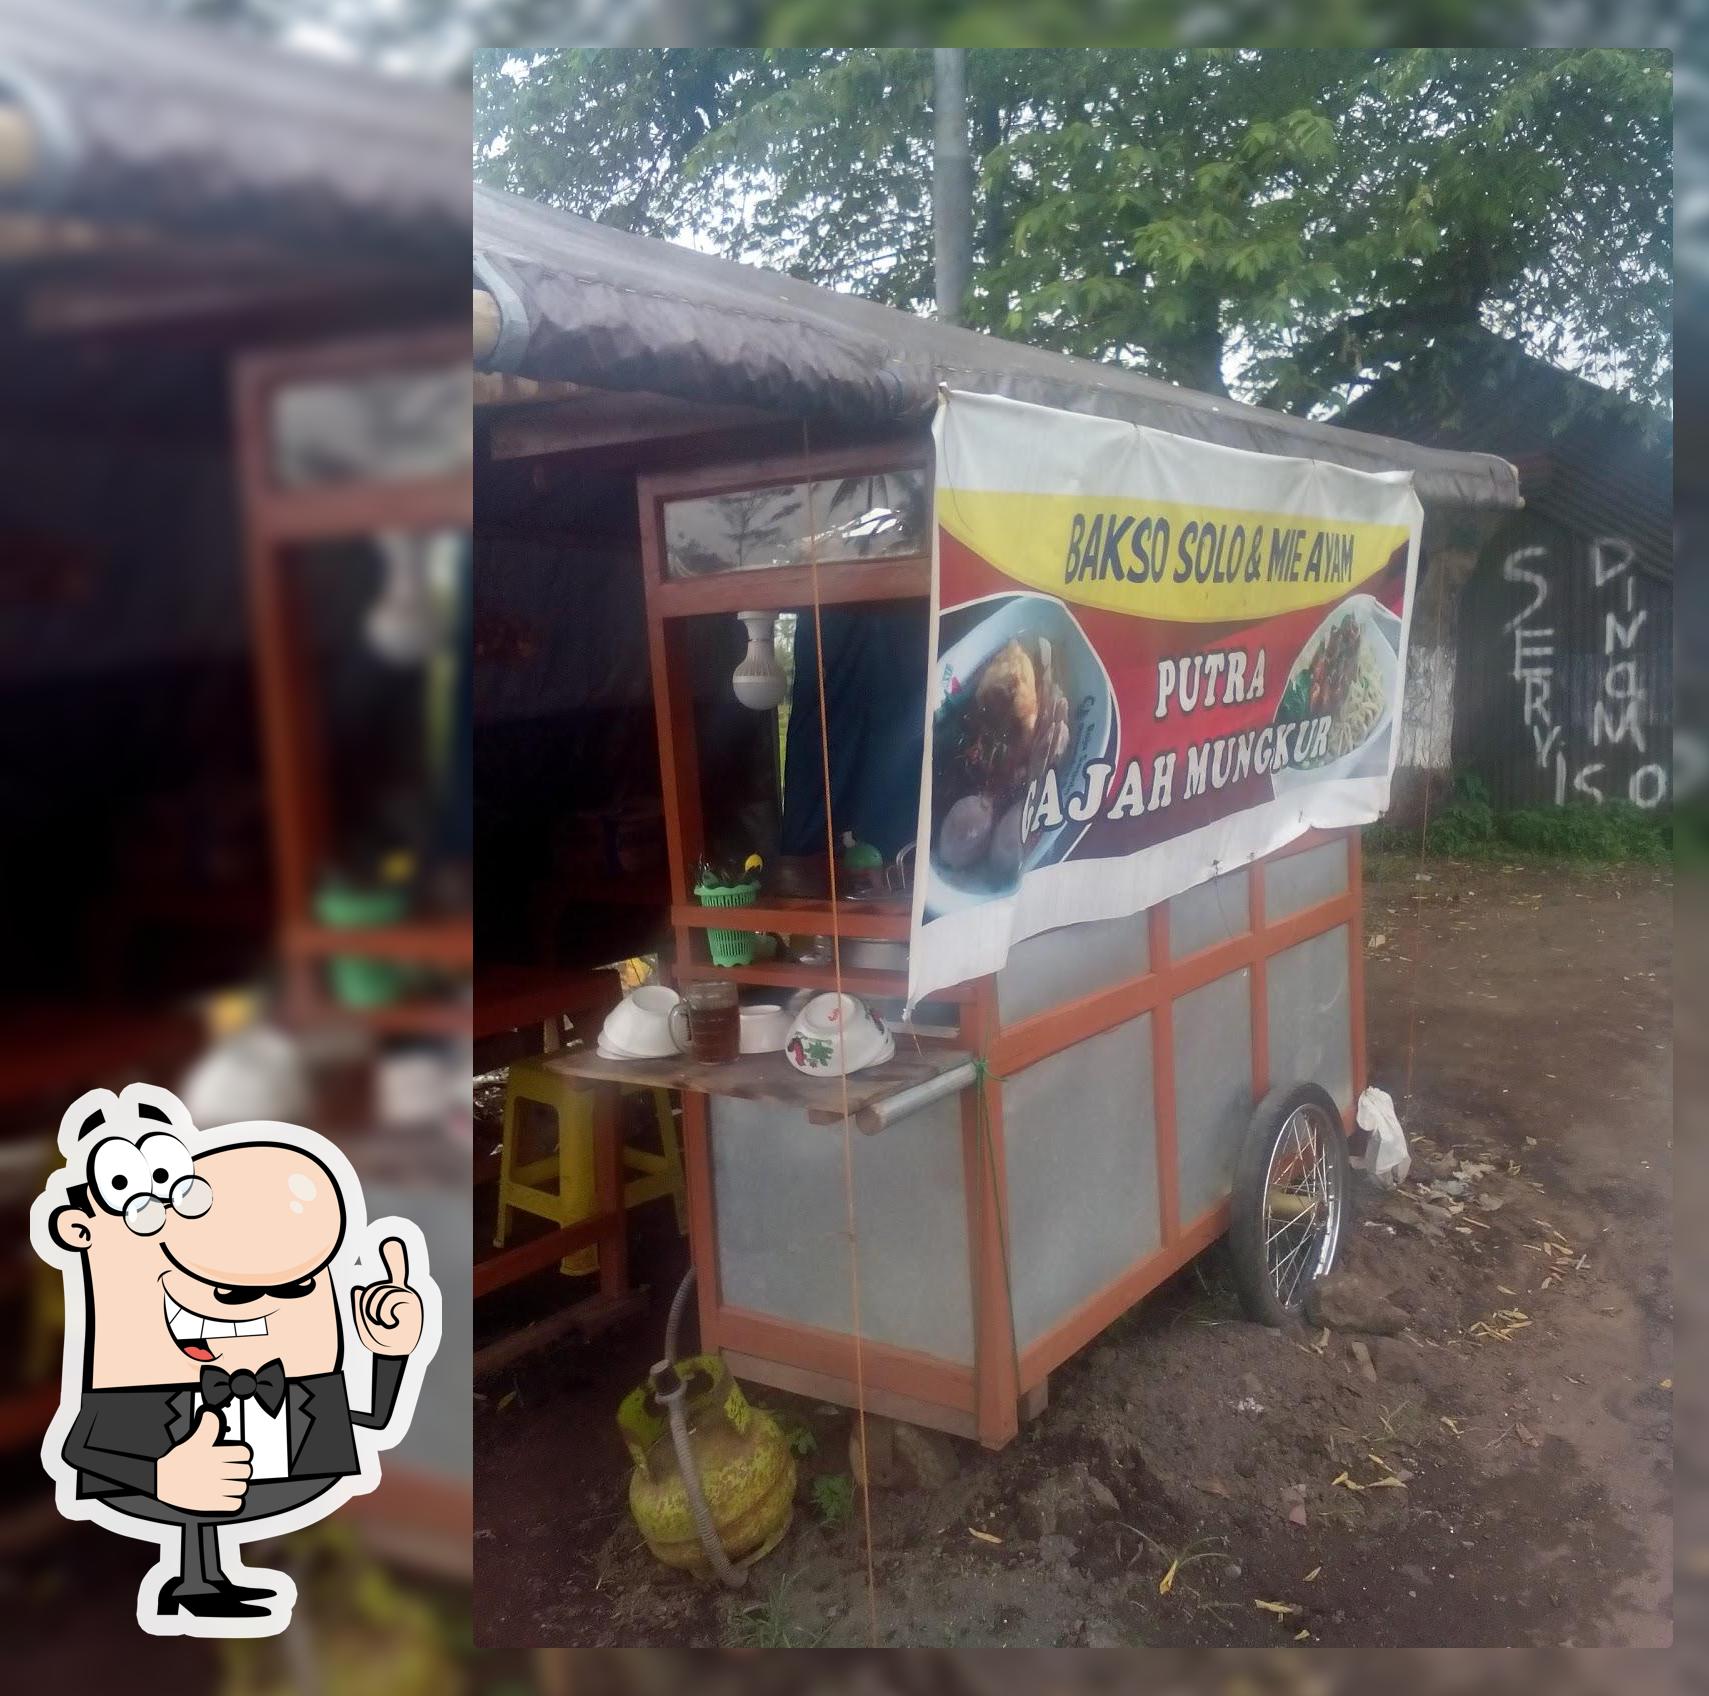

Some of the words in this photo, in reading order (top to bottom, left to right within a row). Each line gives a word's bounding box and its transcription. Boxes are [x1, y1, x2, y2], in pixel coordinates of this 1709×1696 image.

[1064, 513, 1170, 585] BAKSO
[1173, 520, 1245, 584] SOLO
[1244, 525, 1264, 582] &
[1267, 527, 1307, 582] MIE
[1303, 531, 1355, 583] AYAM
[1154, 648, 1266, 719] PUTRA
[1183, 715, 1333, 800] MUNGKUR
